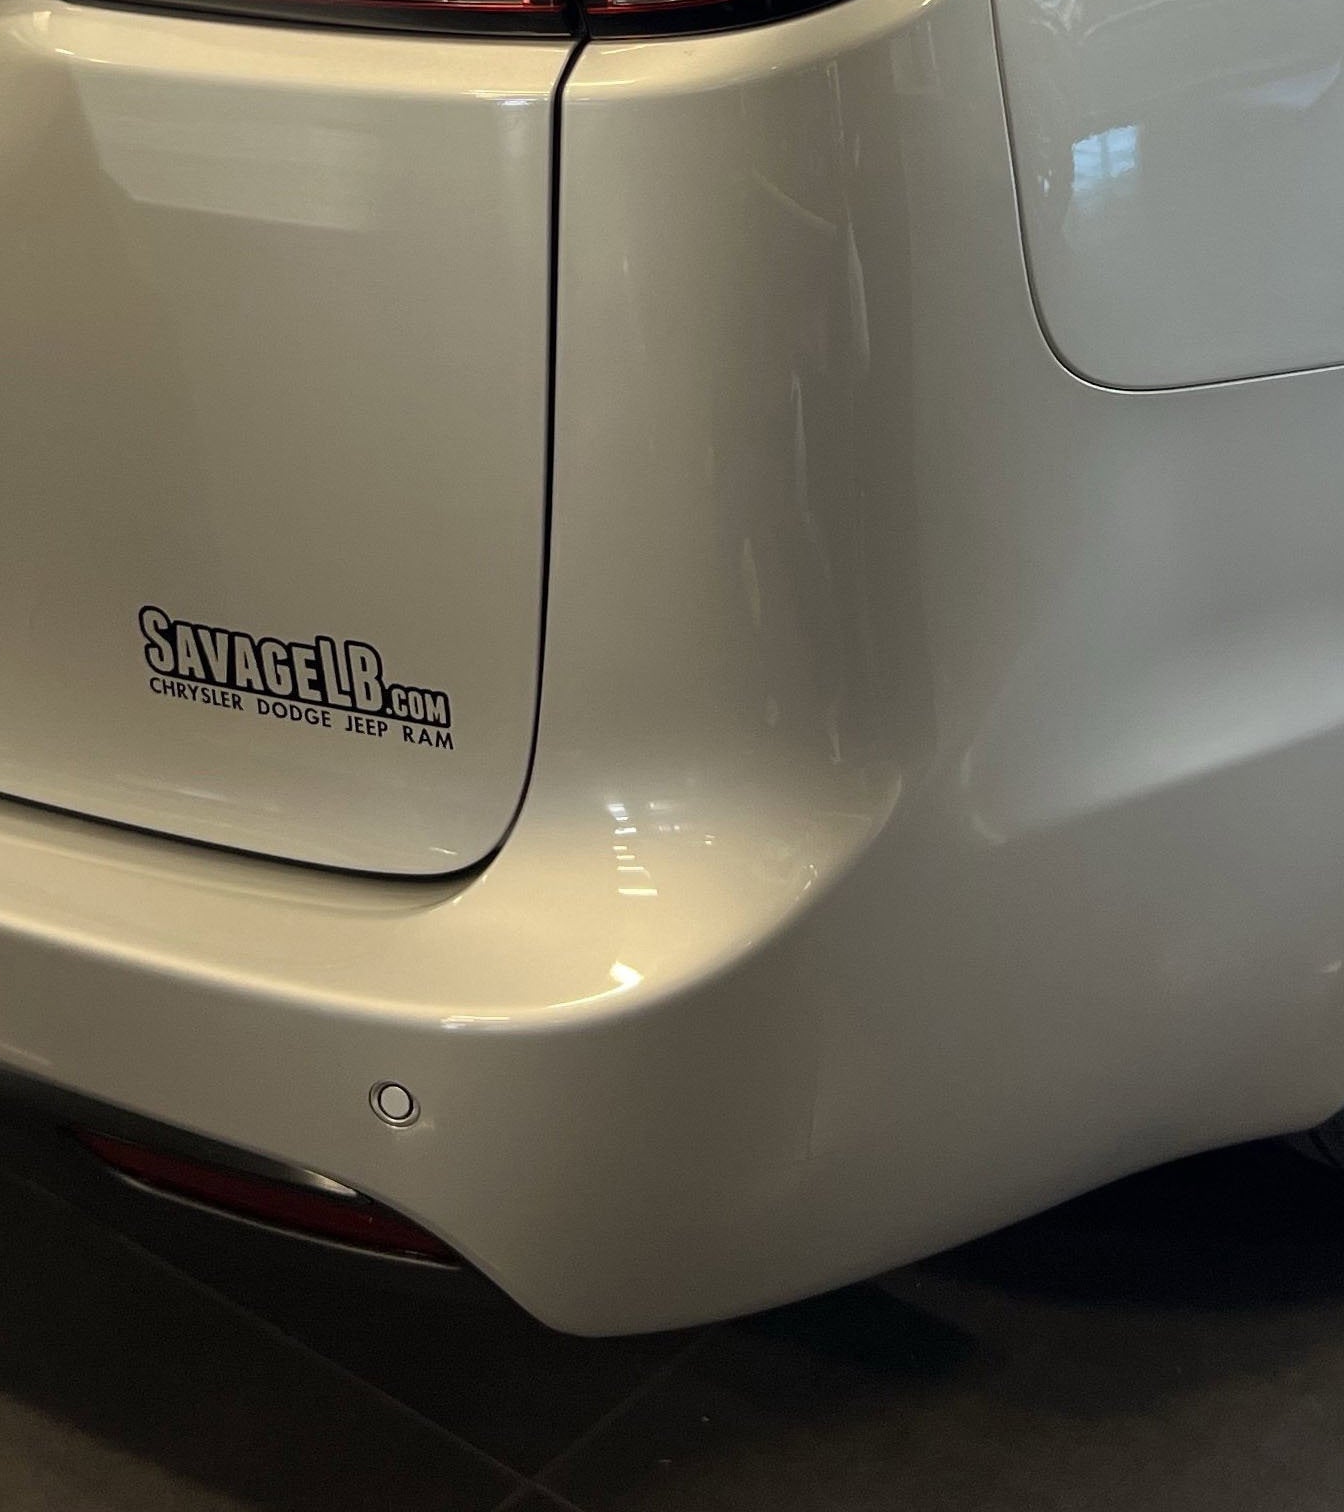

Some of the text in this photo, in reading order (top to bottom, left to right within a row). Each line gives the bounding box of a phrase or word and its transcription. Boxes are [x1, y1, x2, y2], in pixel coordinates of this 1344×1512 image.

[138, 605, 451, 729] SAVAGELB.COM
[149, 676, 455, 750] CHRYSLER DODGE JEEP RAM
